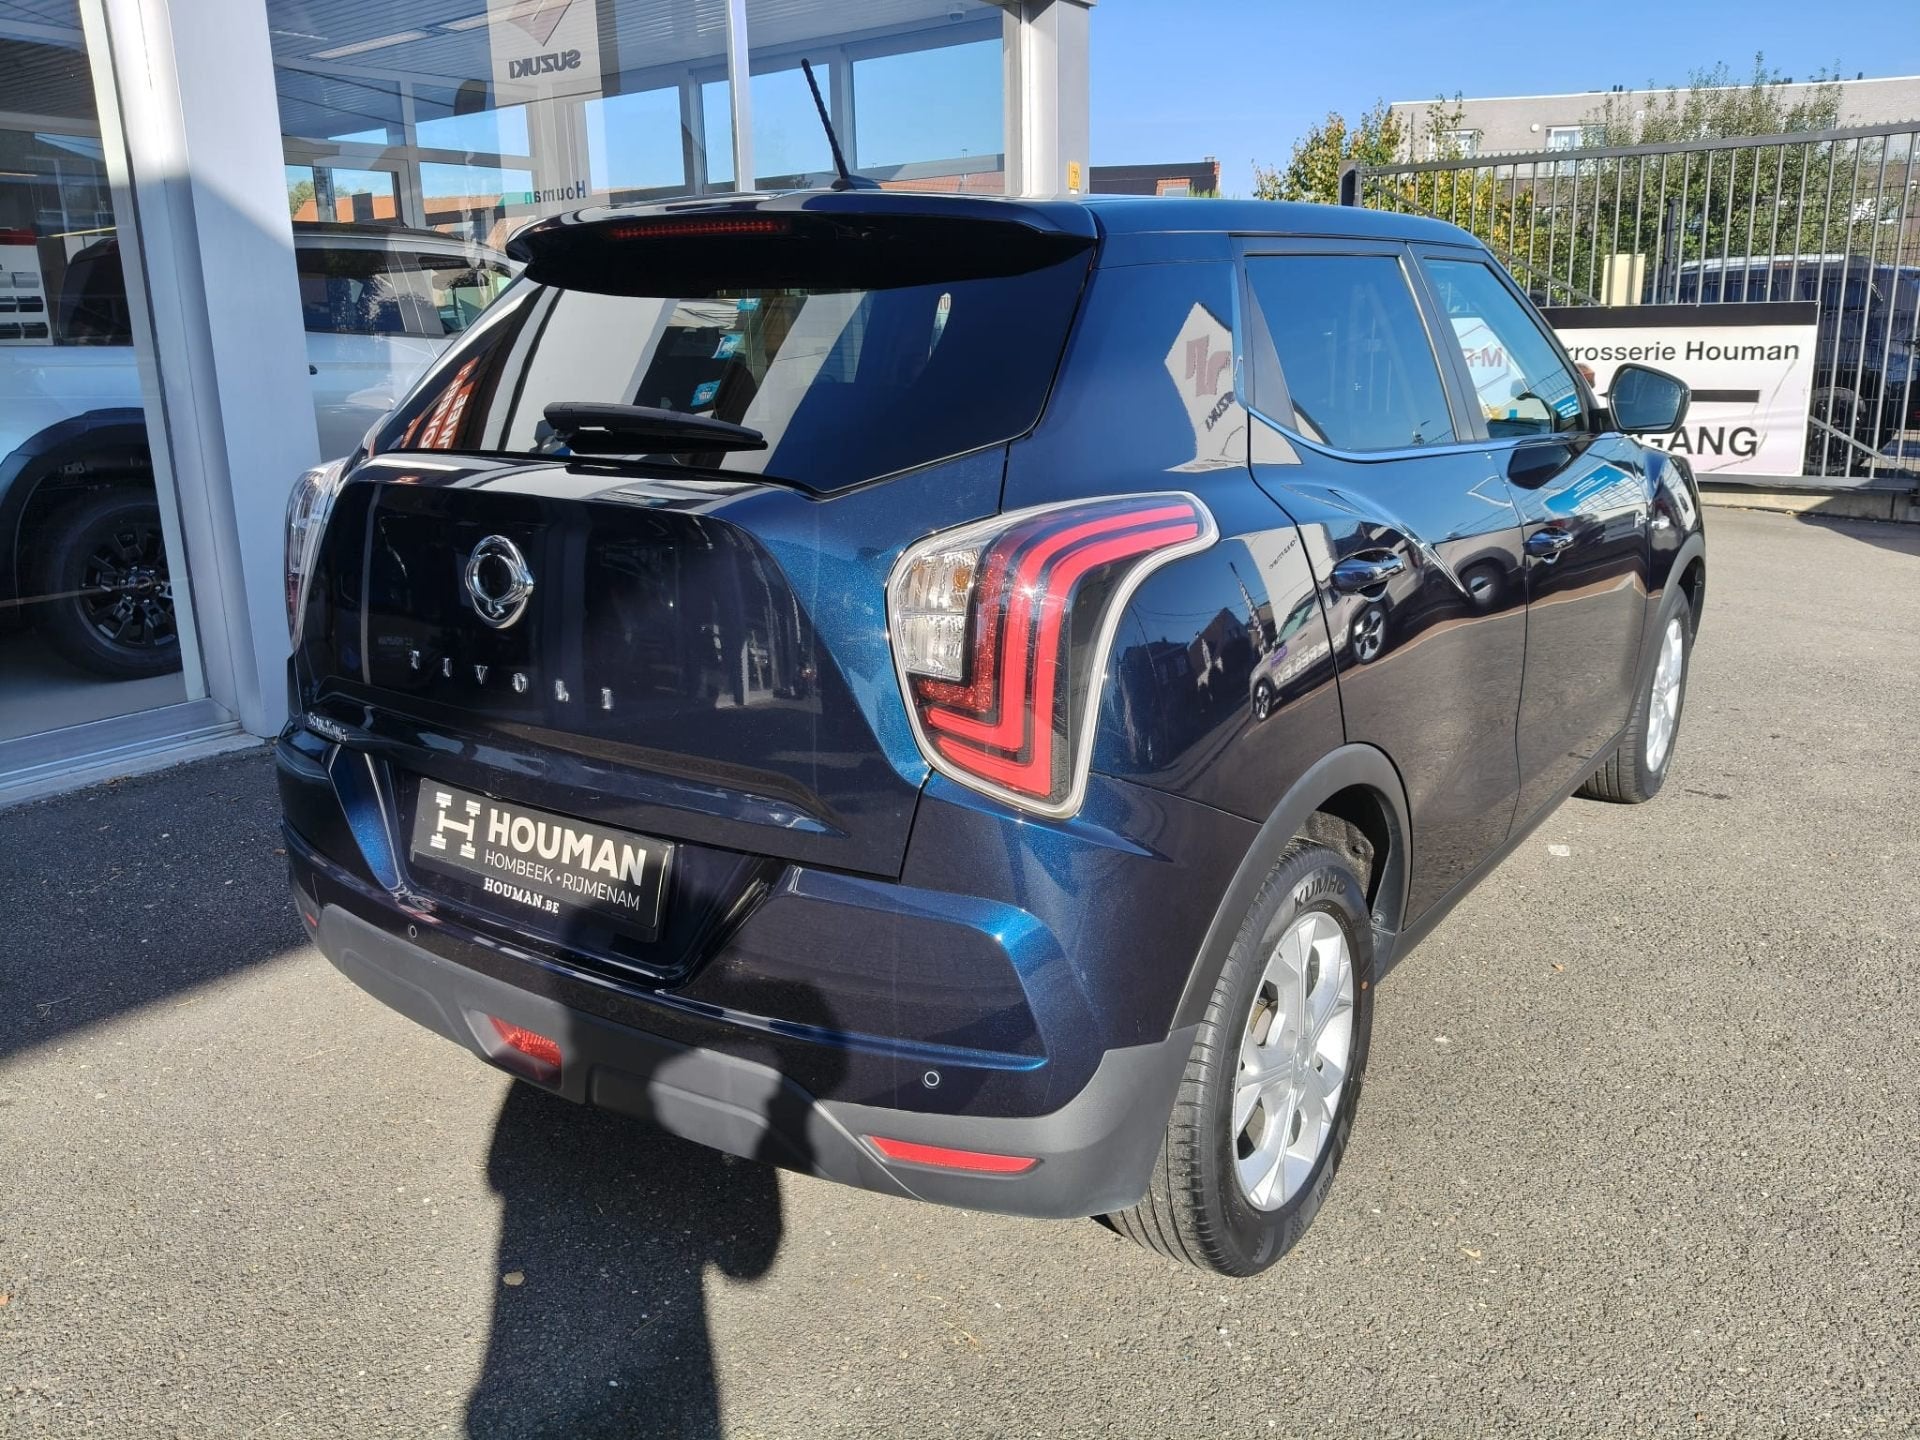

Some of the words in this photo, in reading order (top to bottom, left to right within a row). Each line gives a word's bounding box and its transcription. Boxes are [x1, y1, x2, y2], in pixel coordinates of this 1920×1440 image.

[1685, 341, 1800, 361] Houman
[1638, 426, 1758, 457] ANG
[409, 650, 613, 710] TIVOLI
[487, 808, 647, 887] HOUMAN
[484, 849, 553, 885] HOMBEEK
[562, 873, 640, 912] RIJMENAM
[484, 878, 560, 914] HOUMAN.BE
[1293, 874, 1346, 913] KUMHO
